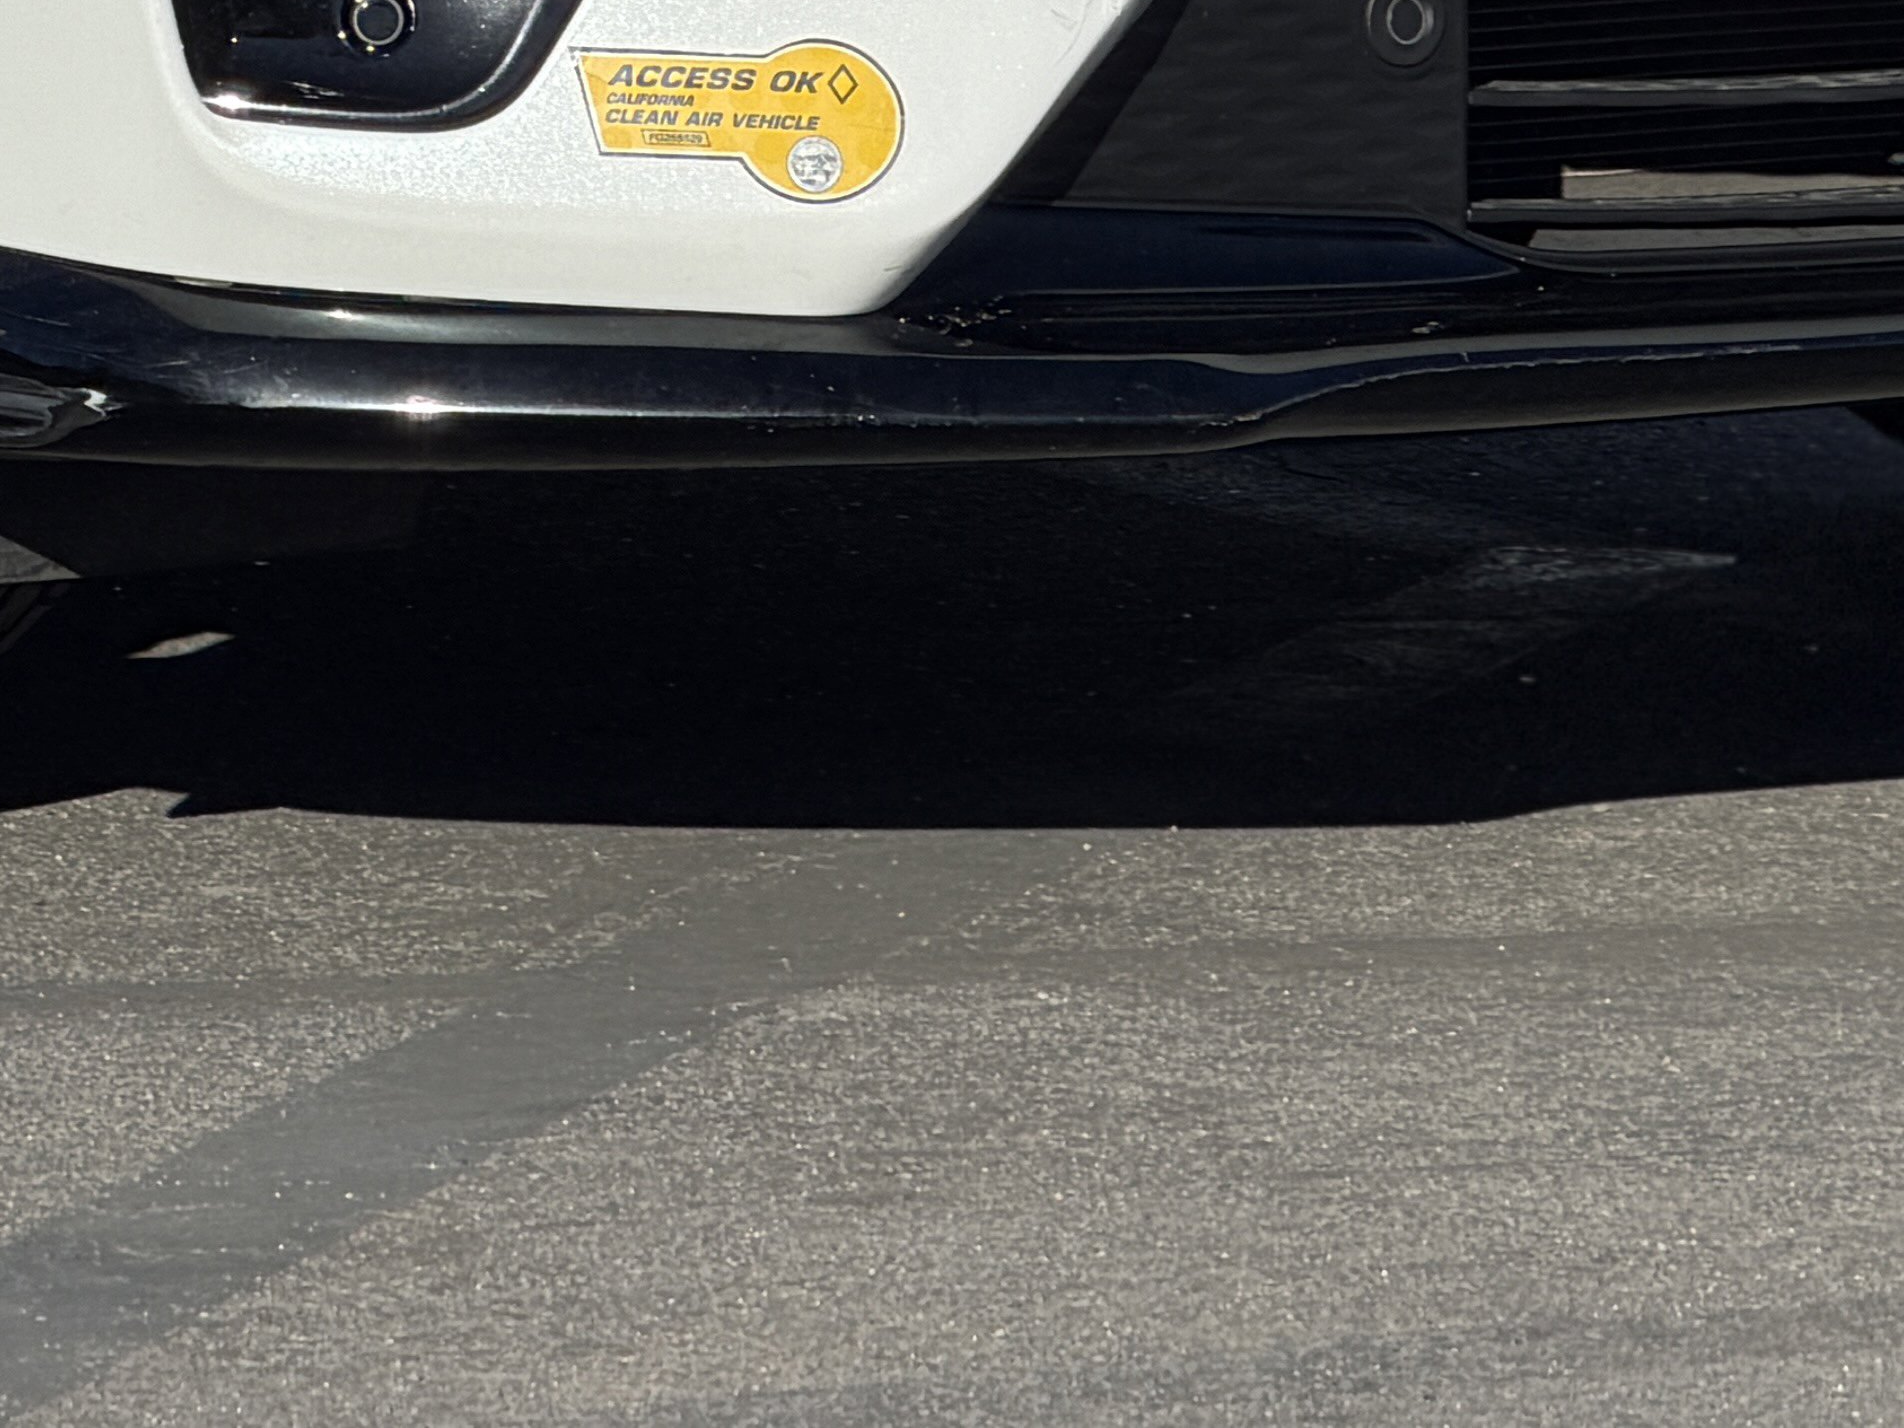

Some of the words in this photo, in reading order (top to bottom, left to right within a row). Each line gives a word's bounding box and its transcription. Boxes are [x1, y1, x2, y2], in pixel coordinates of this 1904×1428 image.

[607, 64, 757, 91] ACCESS
[769, 70, 826, 94] OK
[606, 92, 695, 107] CALIFORNIA
[605, 109, 679, 126] CLEAN
[686, 112, 724, 128] AIR
[732, 114, 821, 131] VEHICLE
